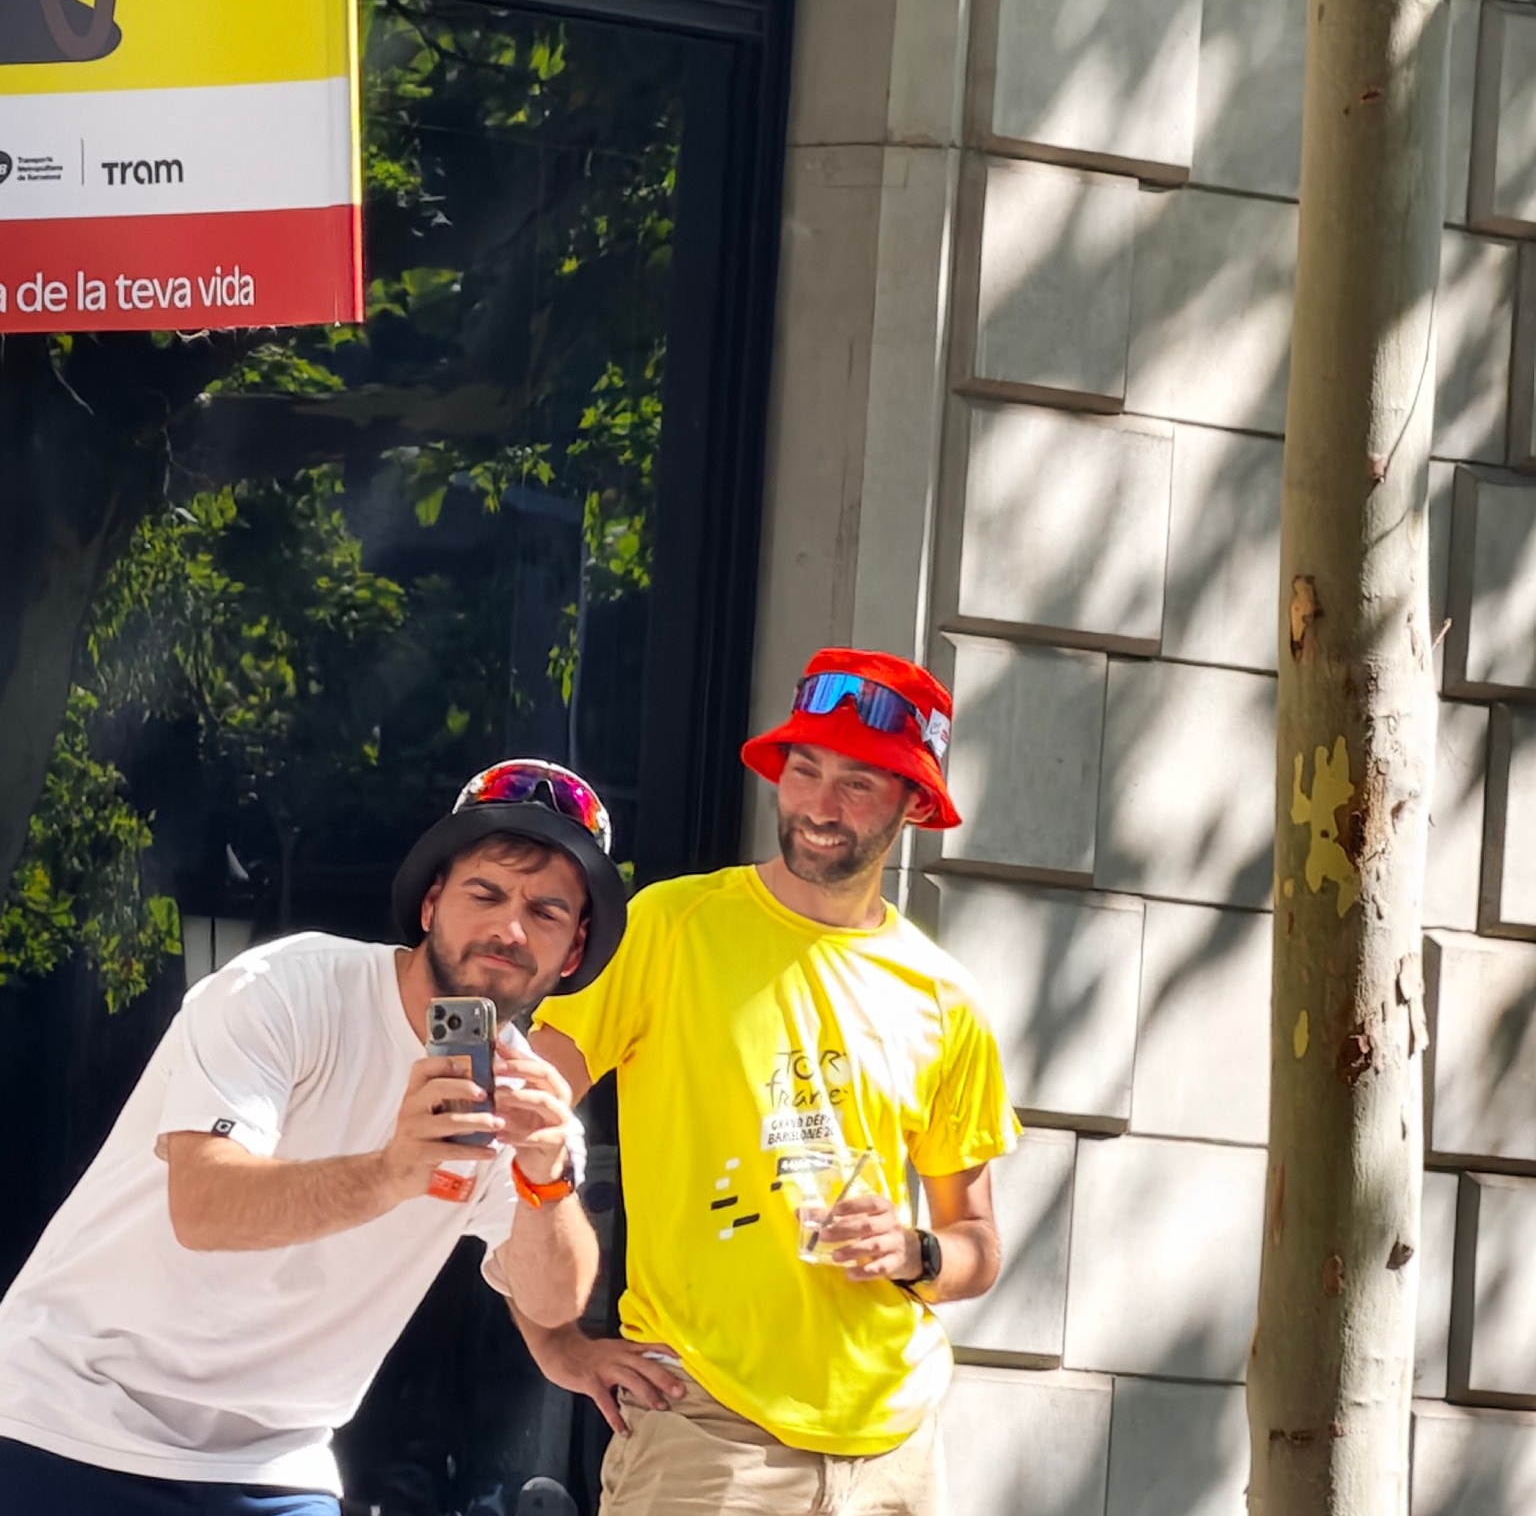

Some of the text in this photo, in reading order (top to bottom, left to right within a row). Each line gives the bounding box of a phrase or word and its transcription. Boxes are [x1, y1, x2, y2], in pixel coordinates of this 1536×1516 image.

[16, 273, 67, 312] de
[76, 272, 105, 311] la
[115, 274, 191, 310] teva
[196, 265, 255, 307] vida
